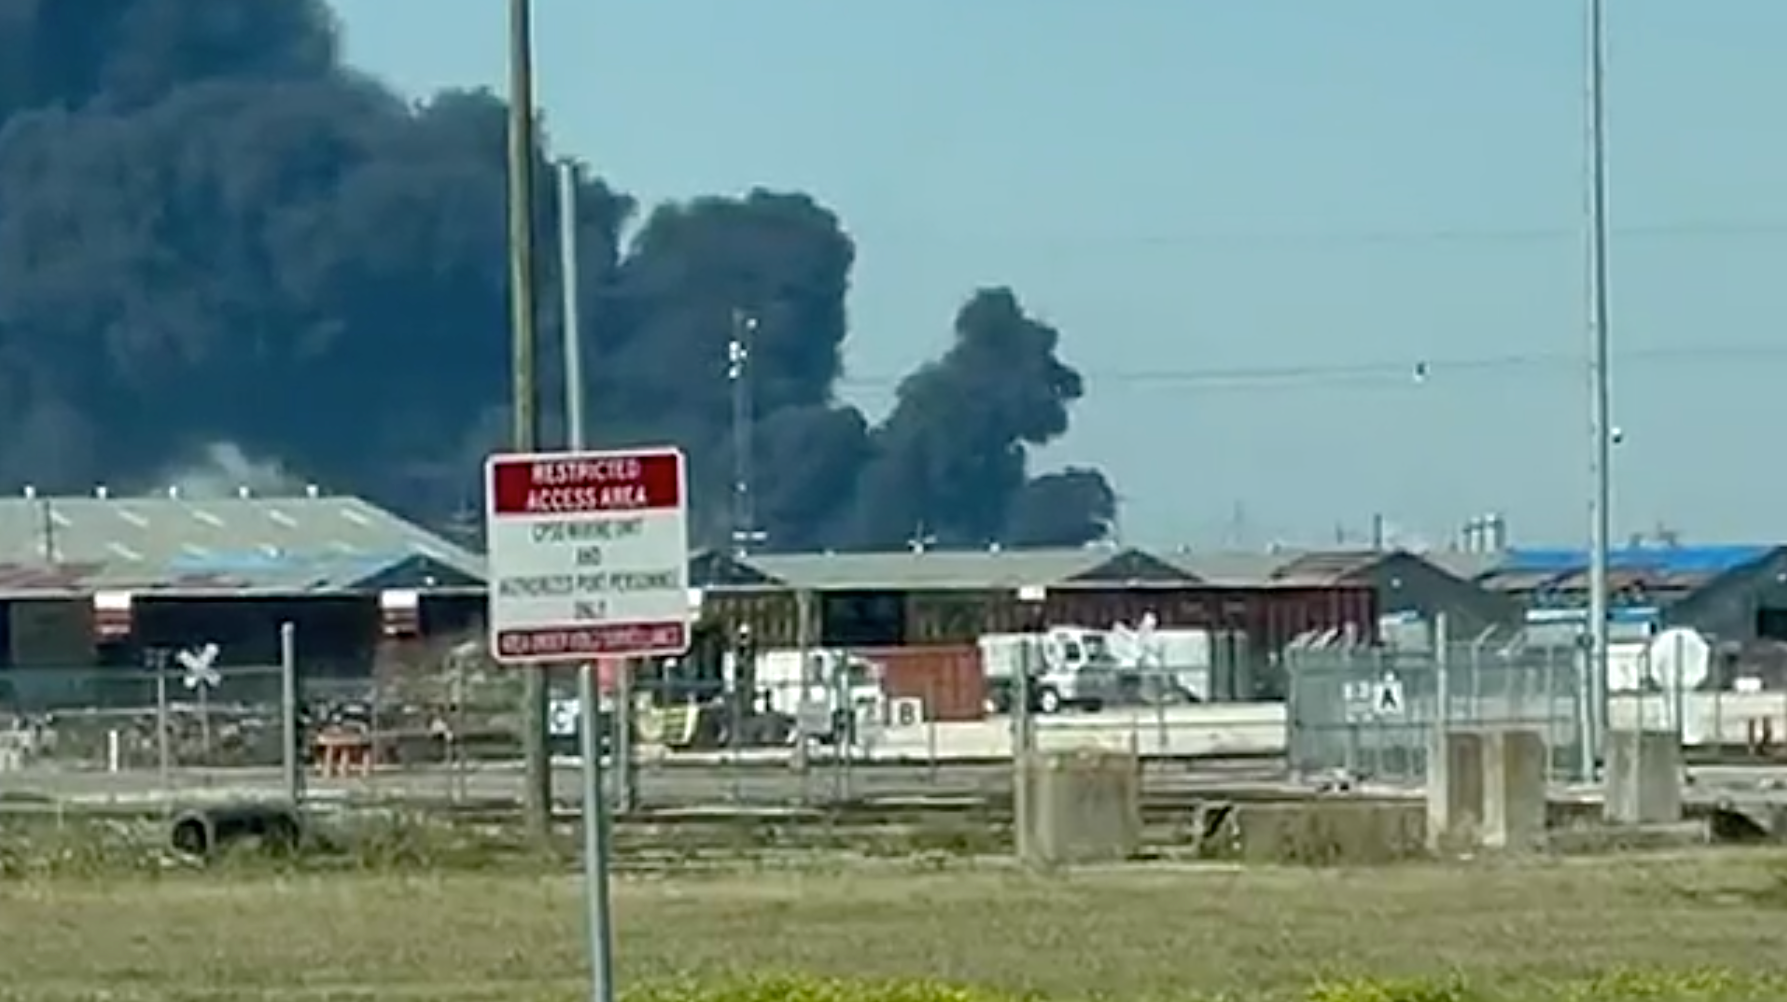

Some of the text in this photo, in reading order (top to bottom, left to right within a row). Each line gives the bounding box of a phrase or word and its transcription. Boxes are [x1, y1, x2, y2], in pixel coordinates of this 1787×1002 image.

[531, 457, 642, 484] RESTRICTED
[527, 484, 647, 510] ACCESS AREA
[1380, 687, 1397, 709] A
